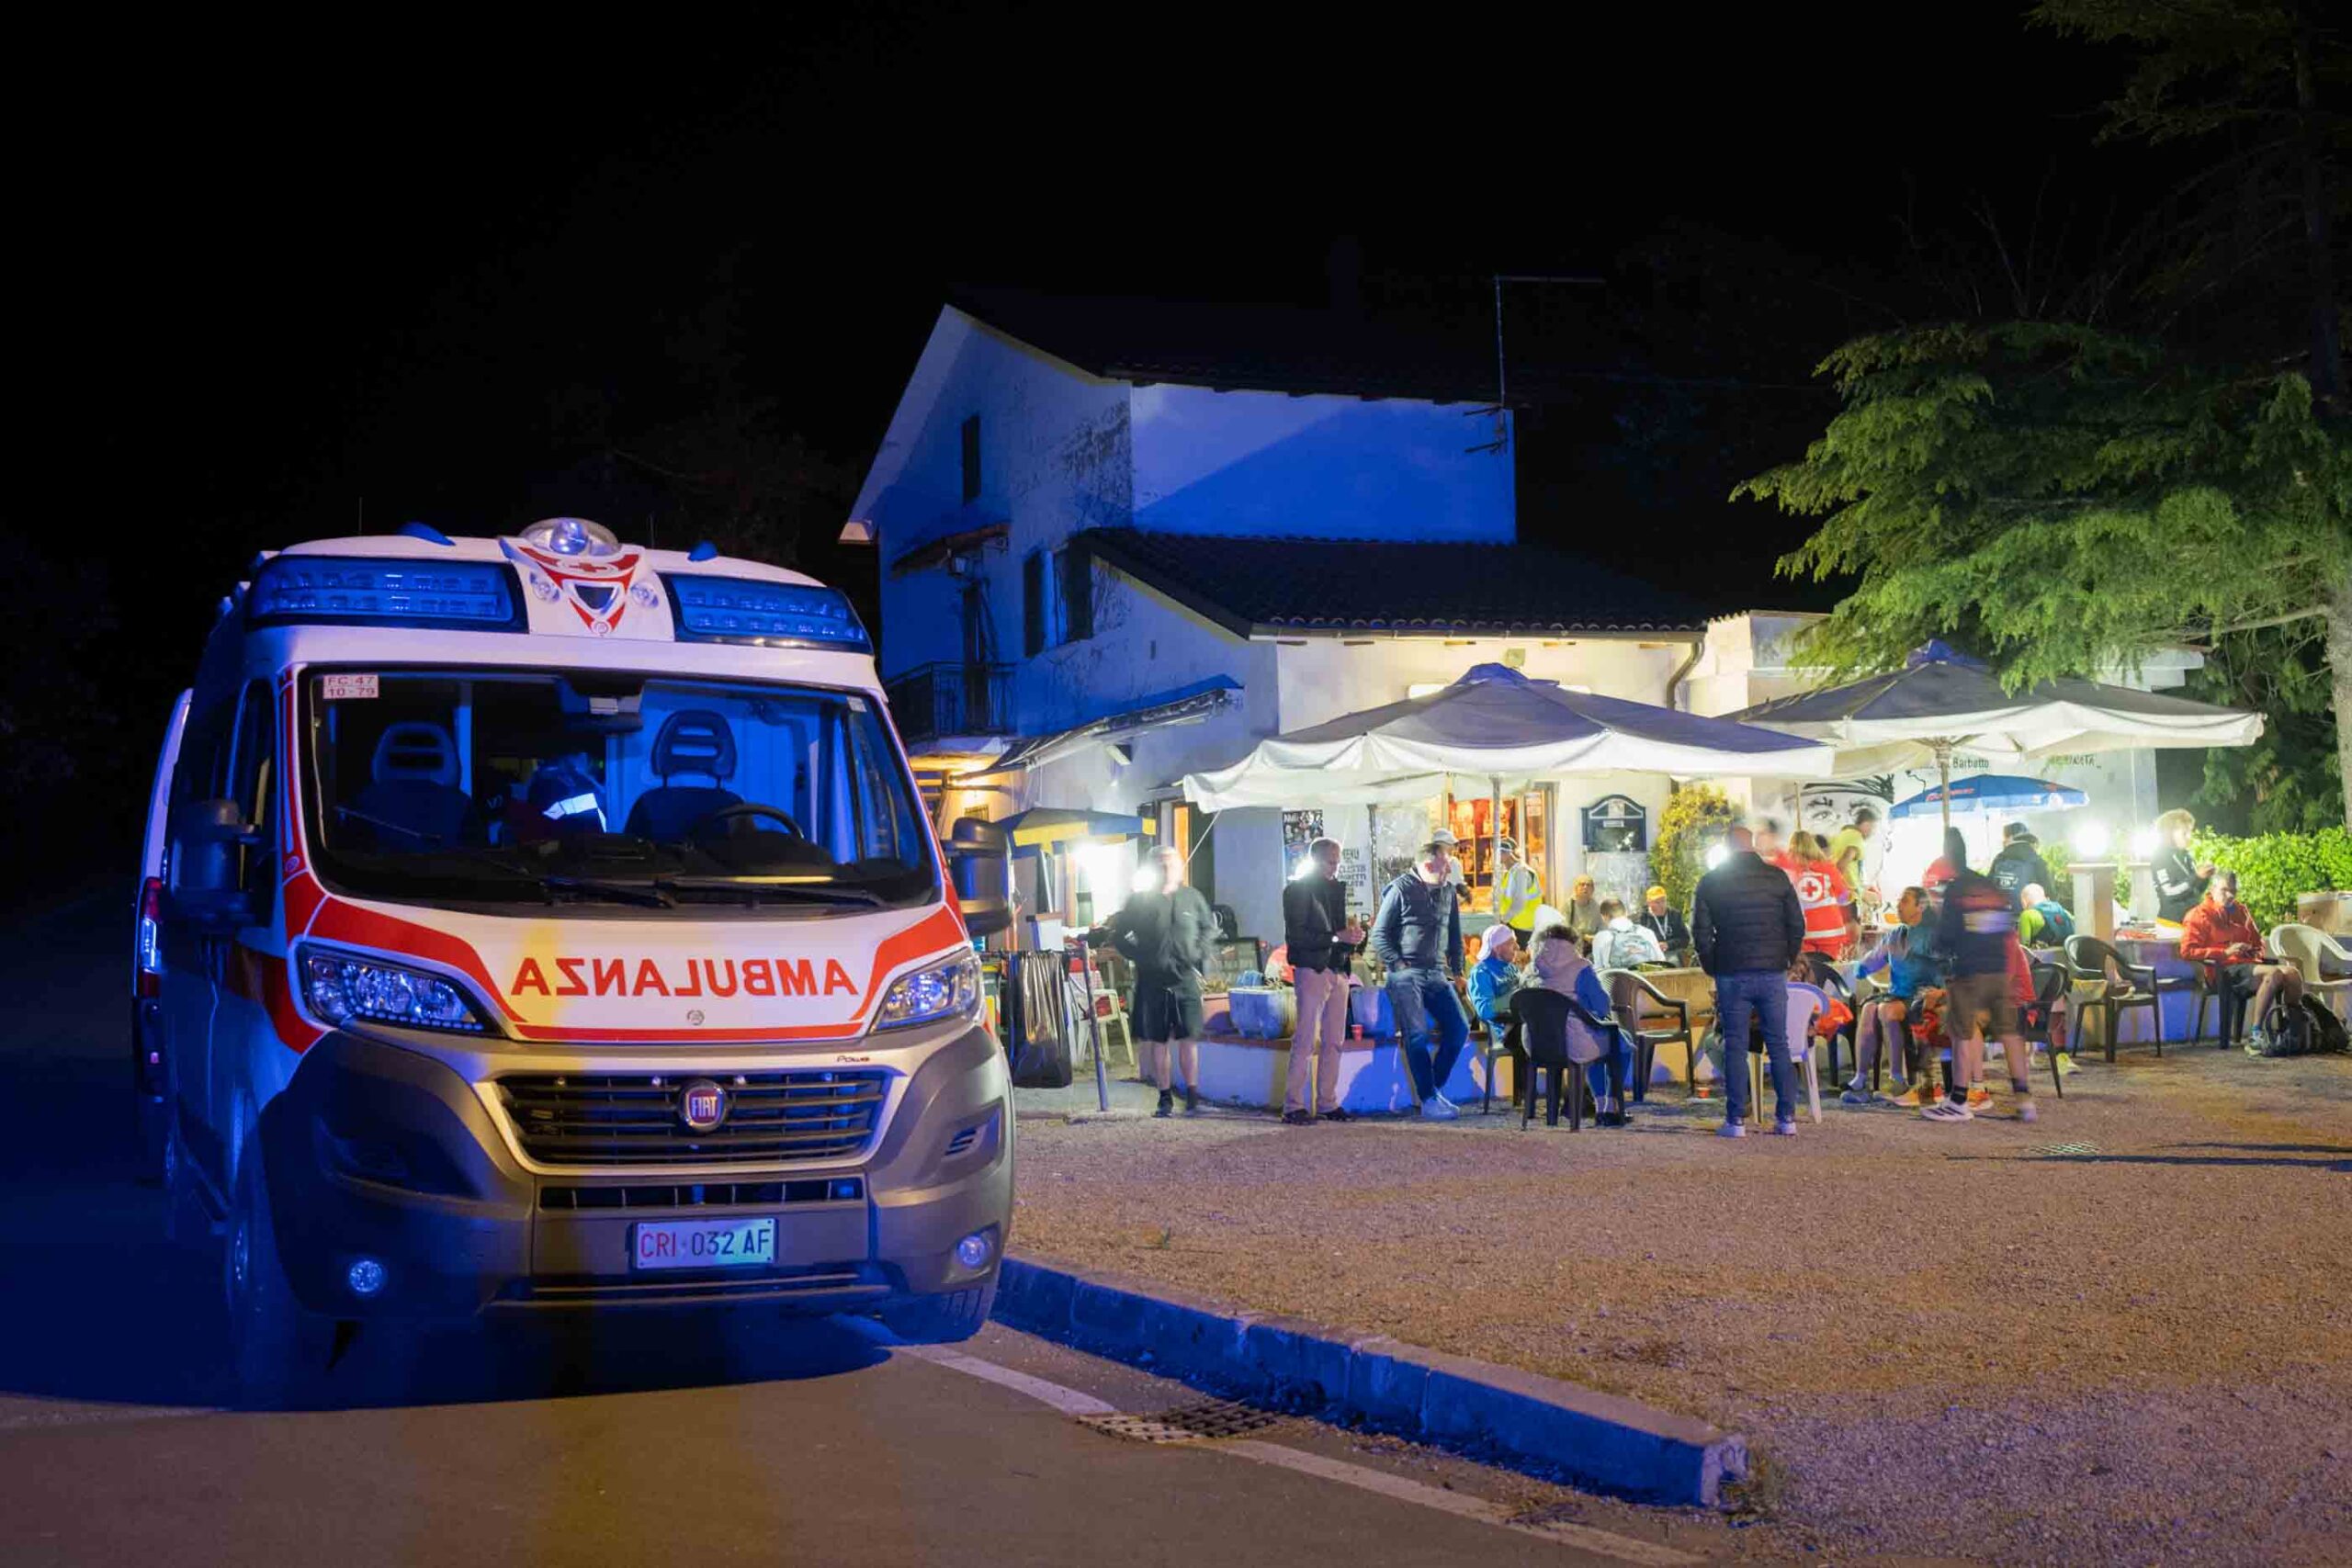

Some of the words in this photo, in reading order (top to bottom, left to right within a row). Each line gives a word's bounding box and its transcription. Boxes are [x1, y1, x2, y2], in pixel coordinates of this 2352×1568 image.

[691, 1096, 718, 1119] FIAT
[639, 1232, 677, 1258] CRI
[691, 1230, 735, 1257] 032
[742, 1228, 772, 1255] AF
